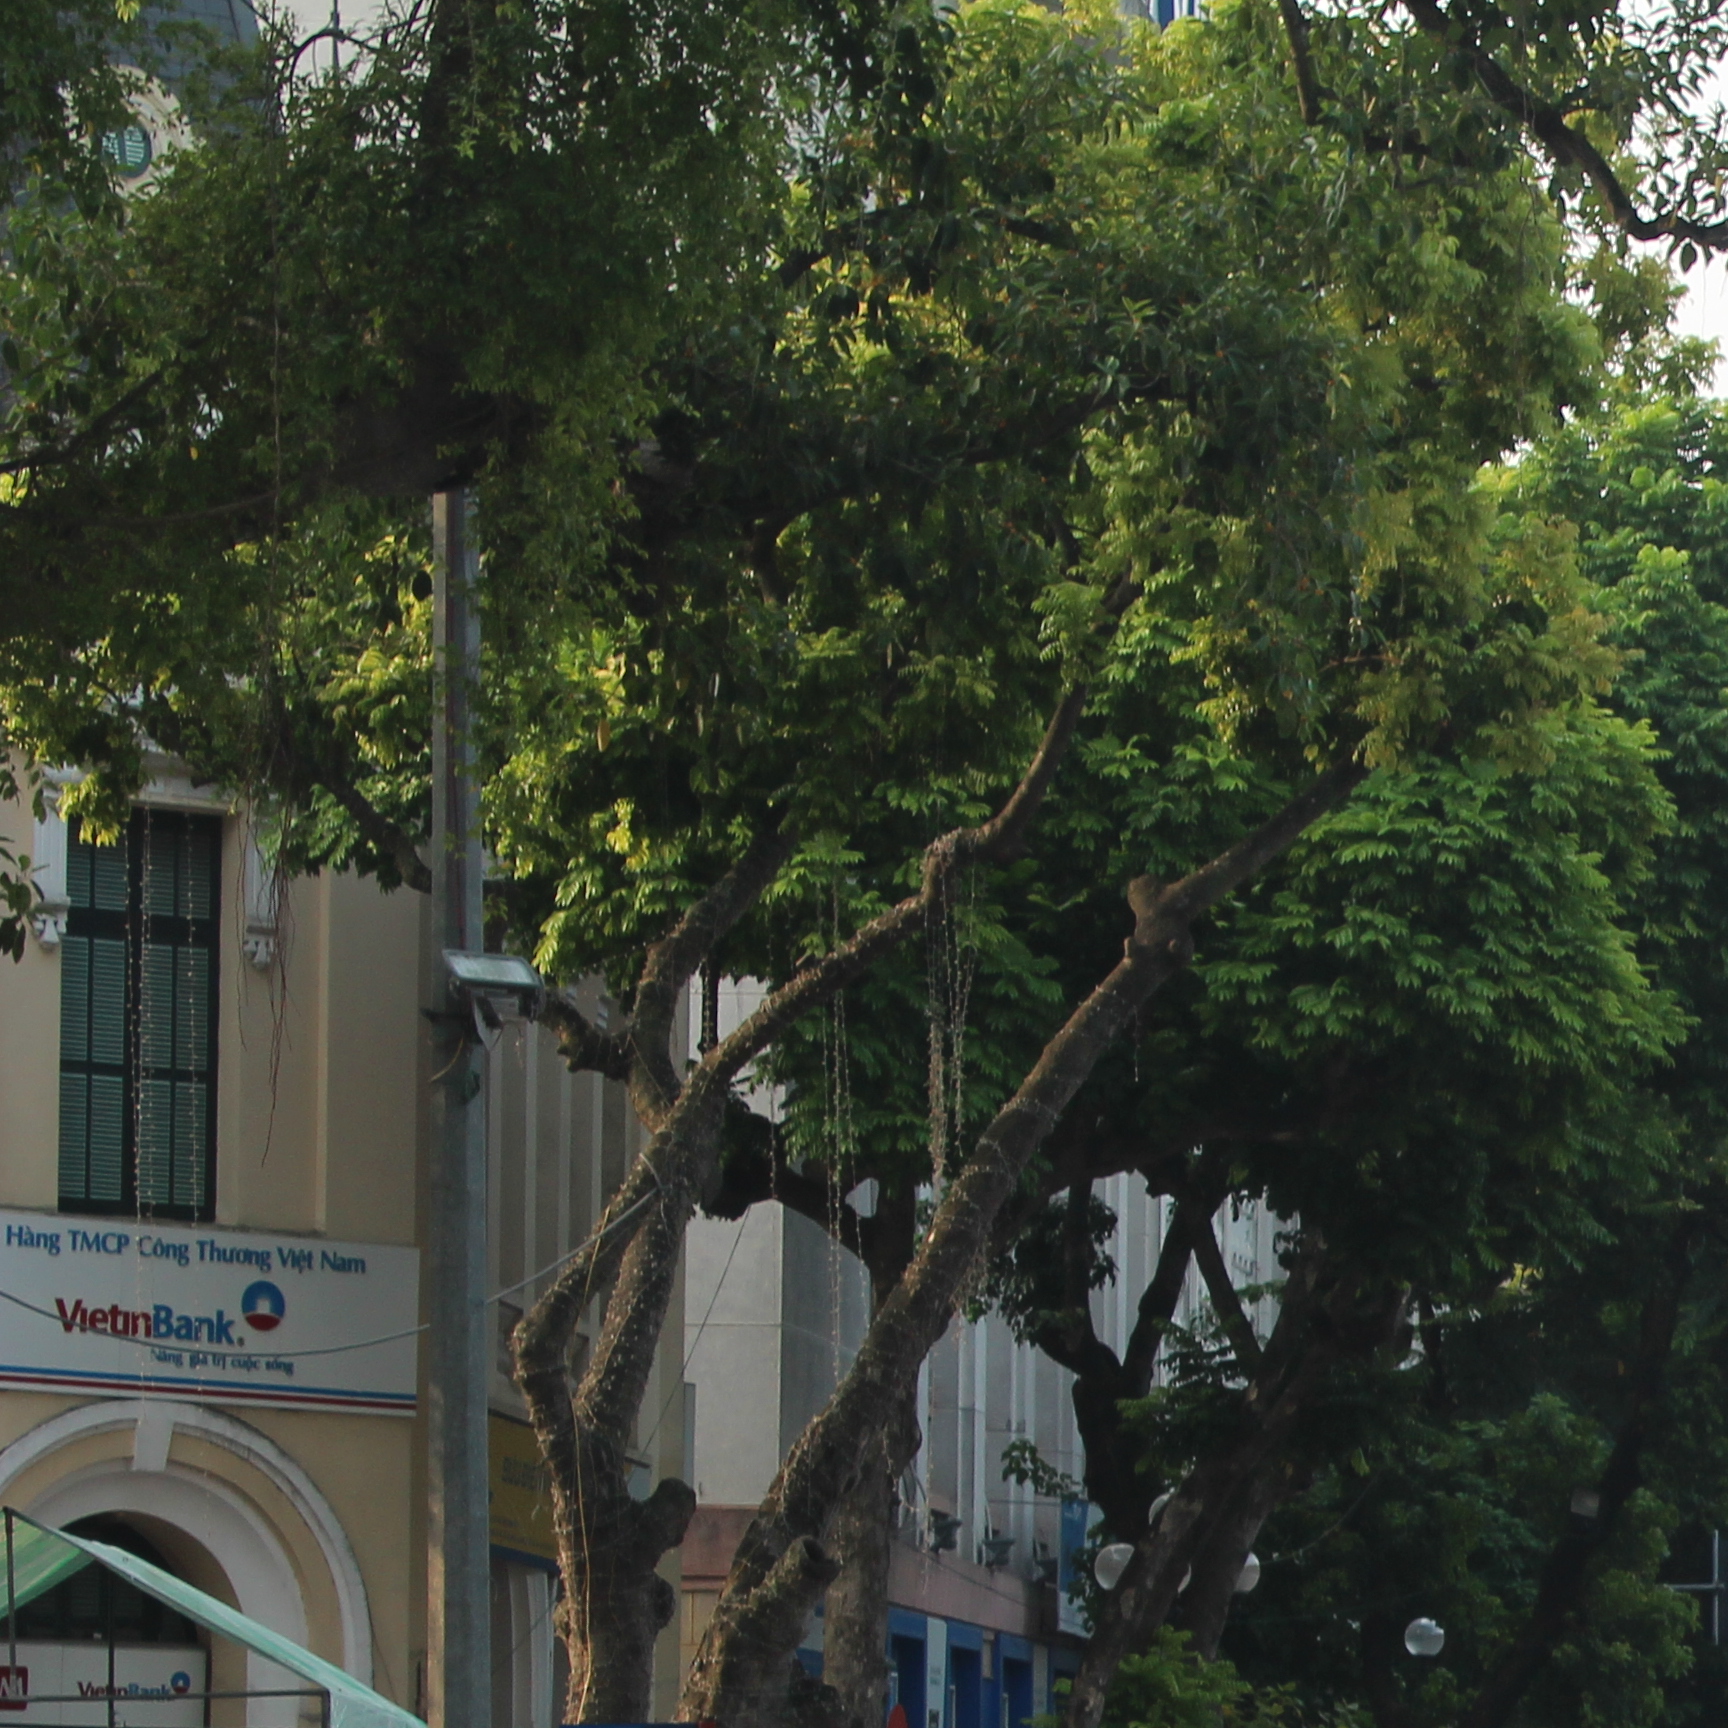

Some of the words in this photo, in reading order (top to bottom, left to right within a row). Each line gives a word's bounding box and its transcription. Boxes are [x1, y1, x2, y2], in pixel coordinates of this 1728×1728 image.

[6, 1225, 61, 1256] Hàng
[68, 1229, 130, 1255] TMCP
[139, 1235, 190, 1266] Công
[196, 1240, 272, 1273] Thương
[276, 1246, 313, 1274] Việt
[320, 1249, 366, 1274] Nam
